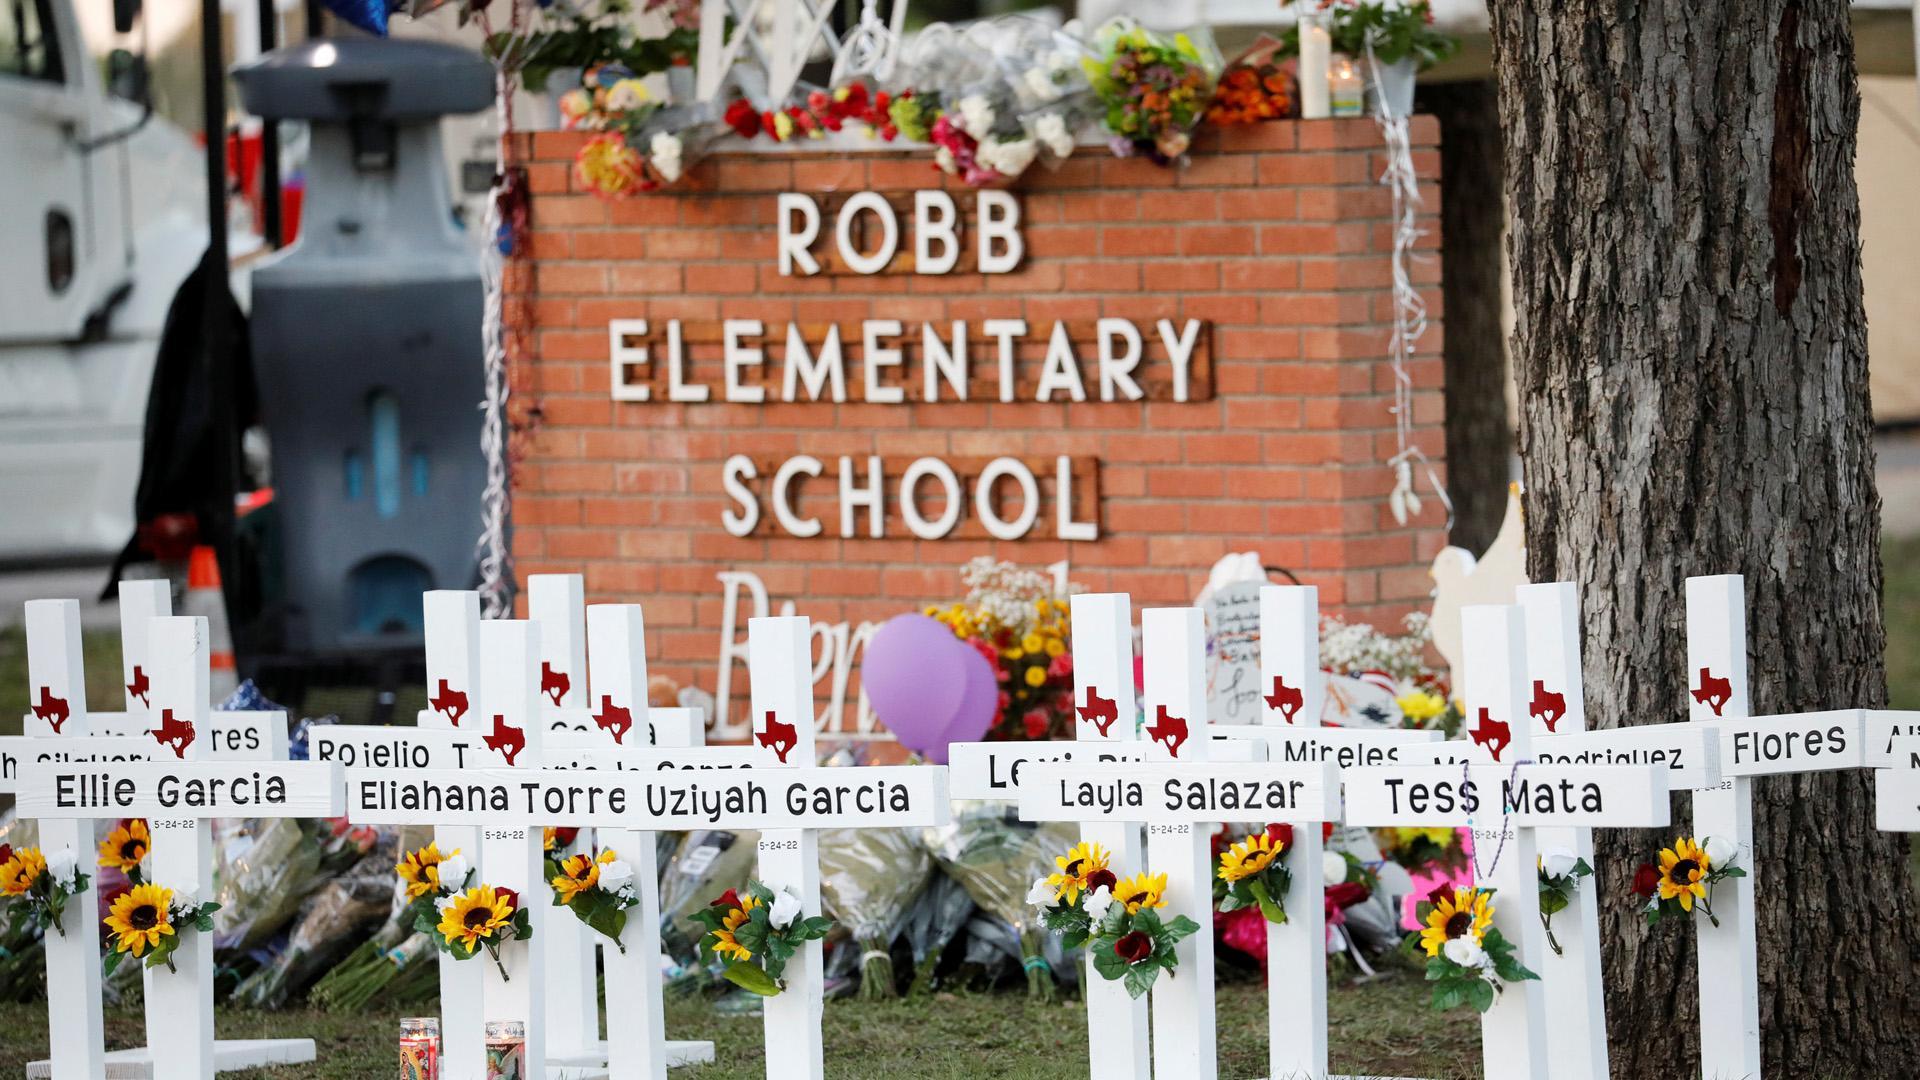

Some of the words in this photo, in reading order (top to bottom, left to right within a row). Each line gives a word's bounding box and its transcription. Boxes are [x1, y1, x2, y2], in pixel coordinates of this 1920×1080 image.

[777, 190, 1024, 276] ROBB
[608, 317, 1201, 403] ELEMENTARY
[721, 454, 1099, 541] SCHOOL
[1285, 739, 1398, 770] Mireles
[1733, 725, 1846, 765] Flores
[56, 773, 136, 808] Ellie
[157, 771, 286, 808] Garcia
[360, 780, 509, 812] Eliahana
[520, 782, 626, 814] Torre
[646, 780, 767, 823] Uziyah
[786, 780, 910, 815] Garcia
[1060, 778, 1143, 814] Layla
[1164, 777, 1305, 811] Salazar
[1384, 778, 1480, 814] Tess
[1501, 778, 1603, 815] Mata
[154, 819, 195, 829] 5-24-22
[485, 830, 525, 840] 5-24-22
[1150, 824, 1190, 834] 5-24-22
[1474, 830, 1514, 840] 5-24-22
[759, 840, 799, 850] 5-24-22
